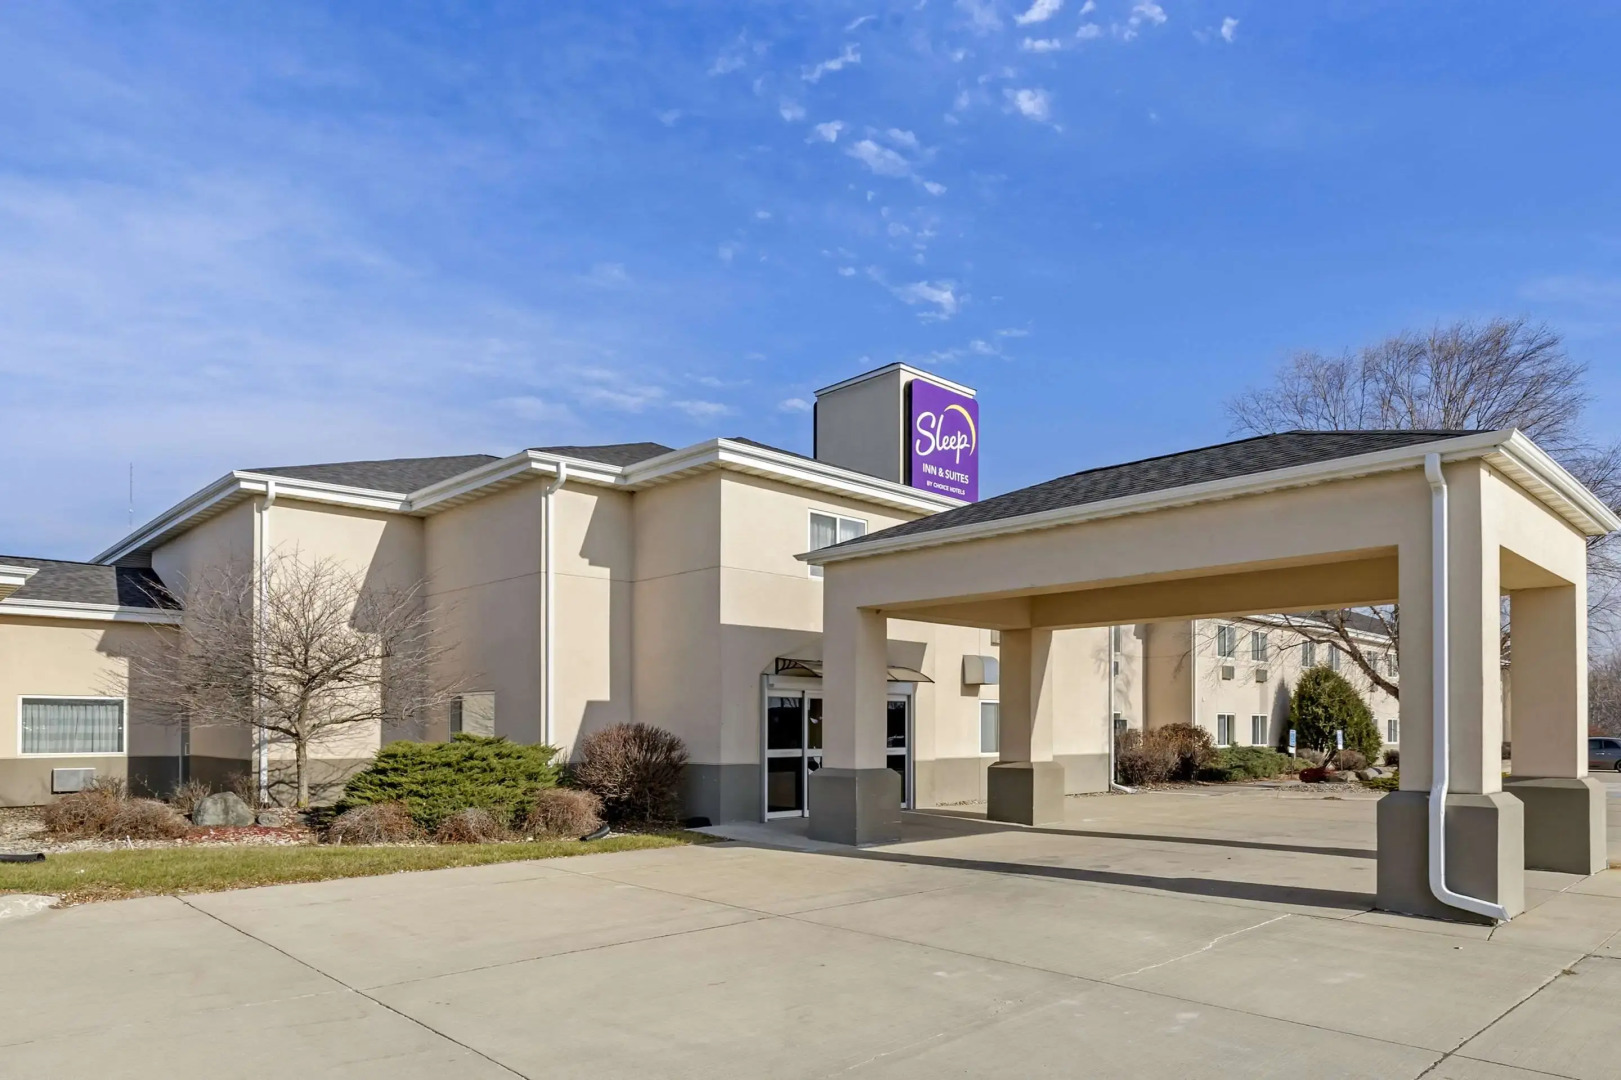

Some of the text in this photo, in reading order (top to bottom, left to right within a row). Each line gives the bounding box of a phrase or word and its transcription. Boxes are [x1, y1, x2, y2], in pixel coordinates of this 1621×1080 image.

[915, 411, 970, 464] Sleep
[922, 463, 969, 484] INN & SUITES
[933, 482, 949, 491] CHOICE
[950, 486, 966, 495] HOTELS
